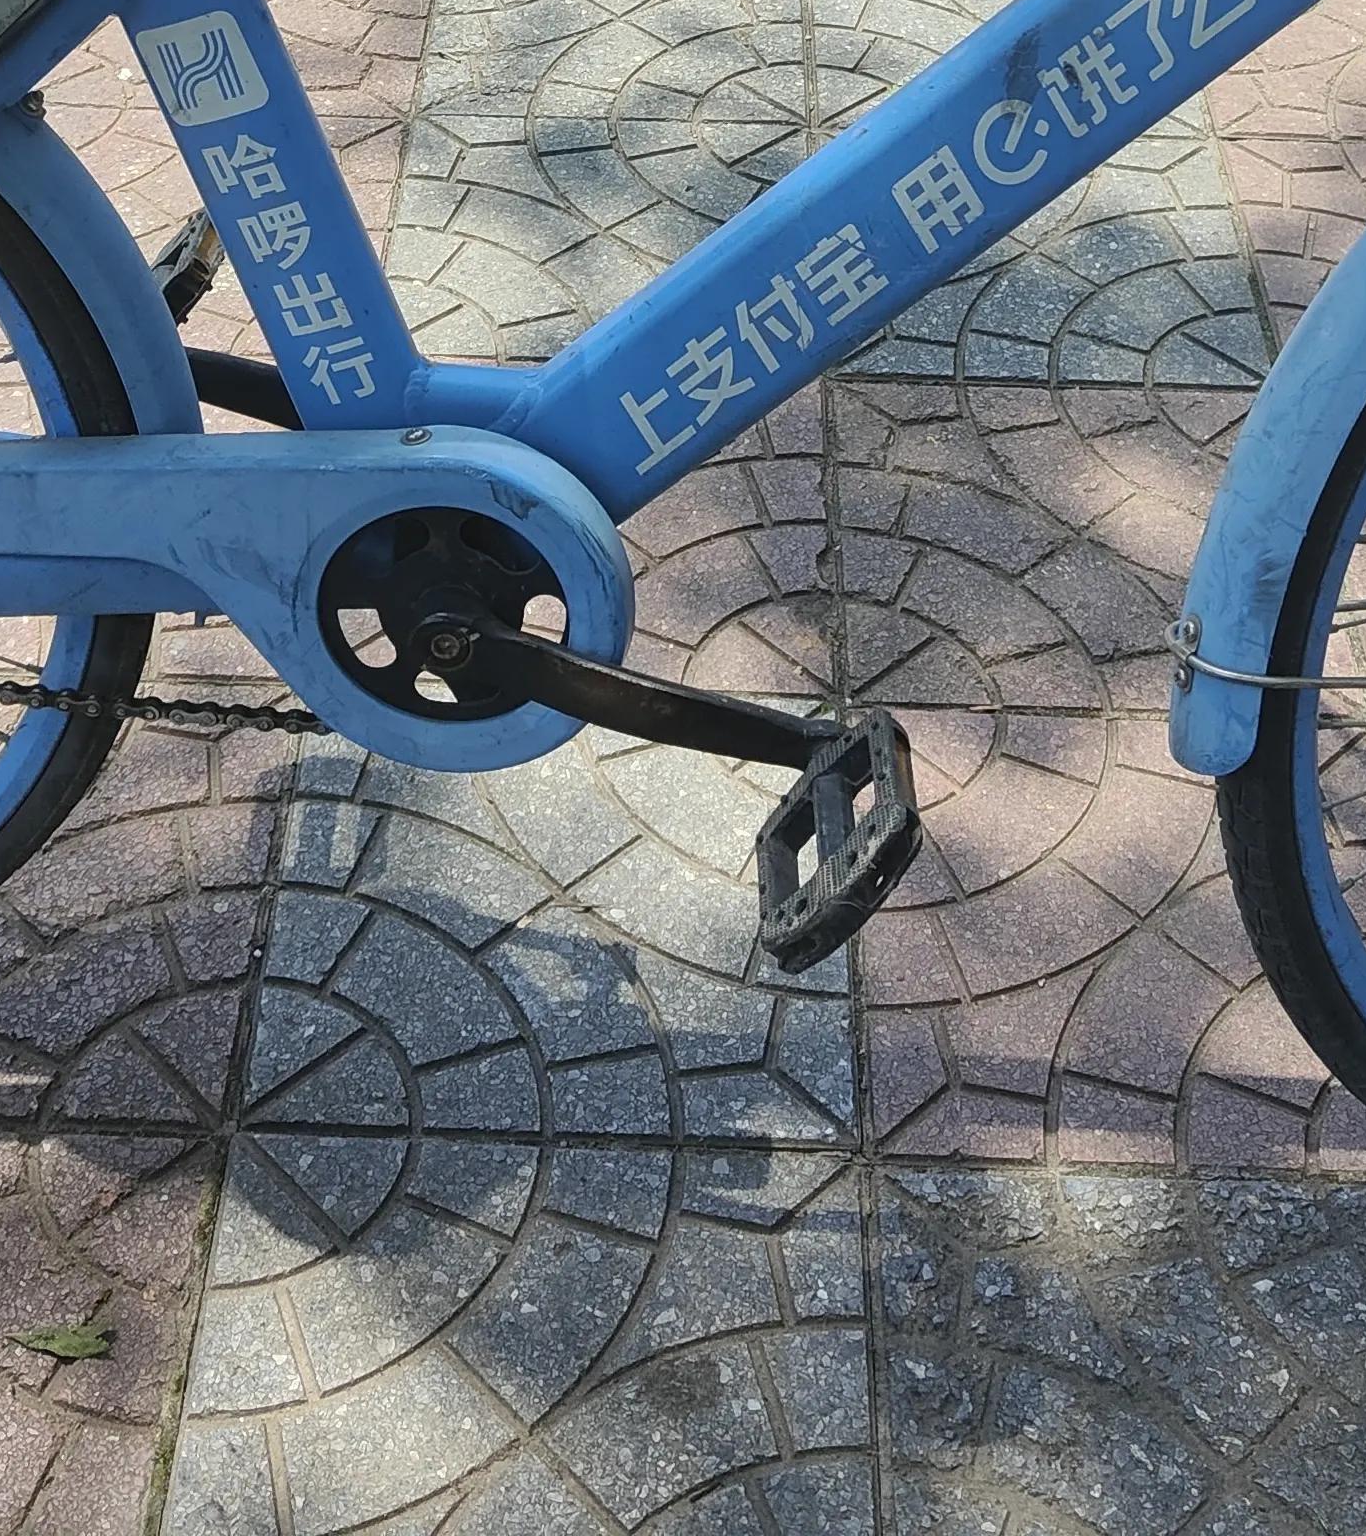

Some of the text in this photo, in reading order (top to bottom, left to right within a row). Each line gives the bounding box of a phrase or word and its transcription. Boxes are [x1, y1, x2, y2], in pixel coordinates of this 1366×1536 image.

[201, 133, 377, 405] 哈啰出行
[618, 222, 889, 476] 上支付宝
